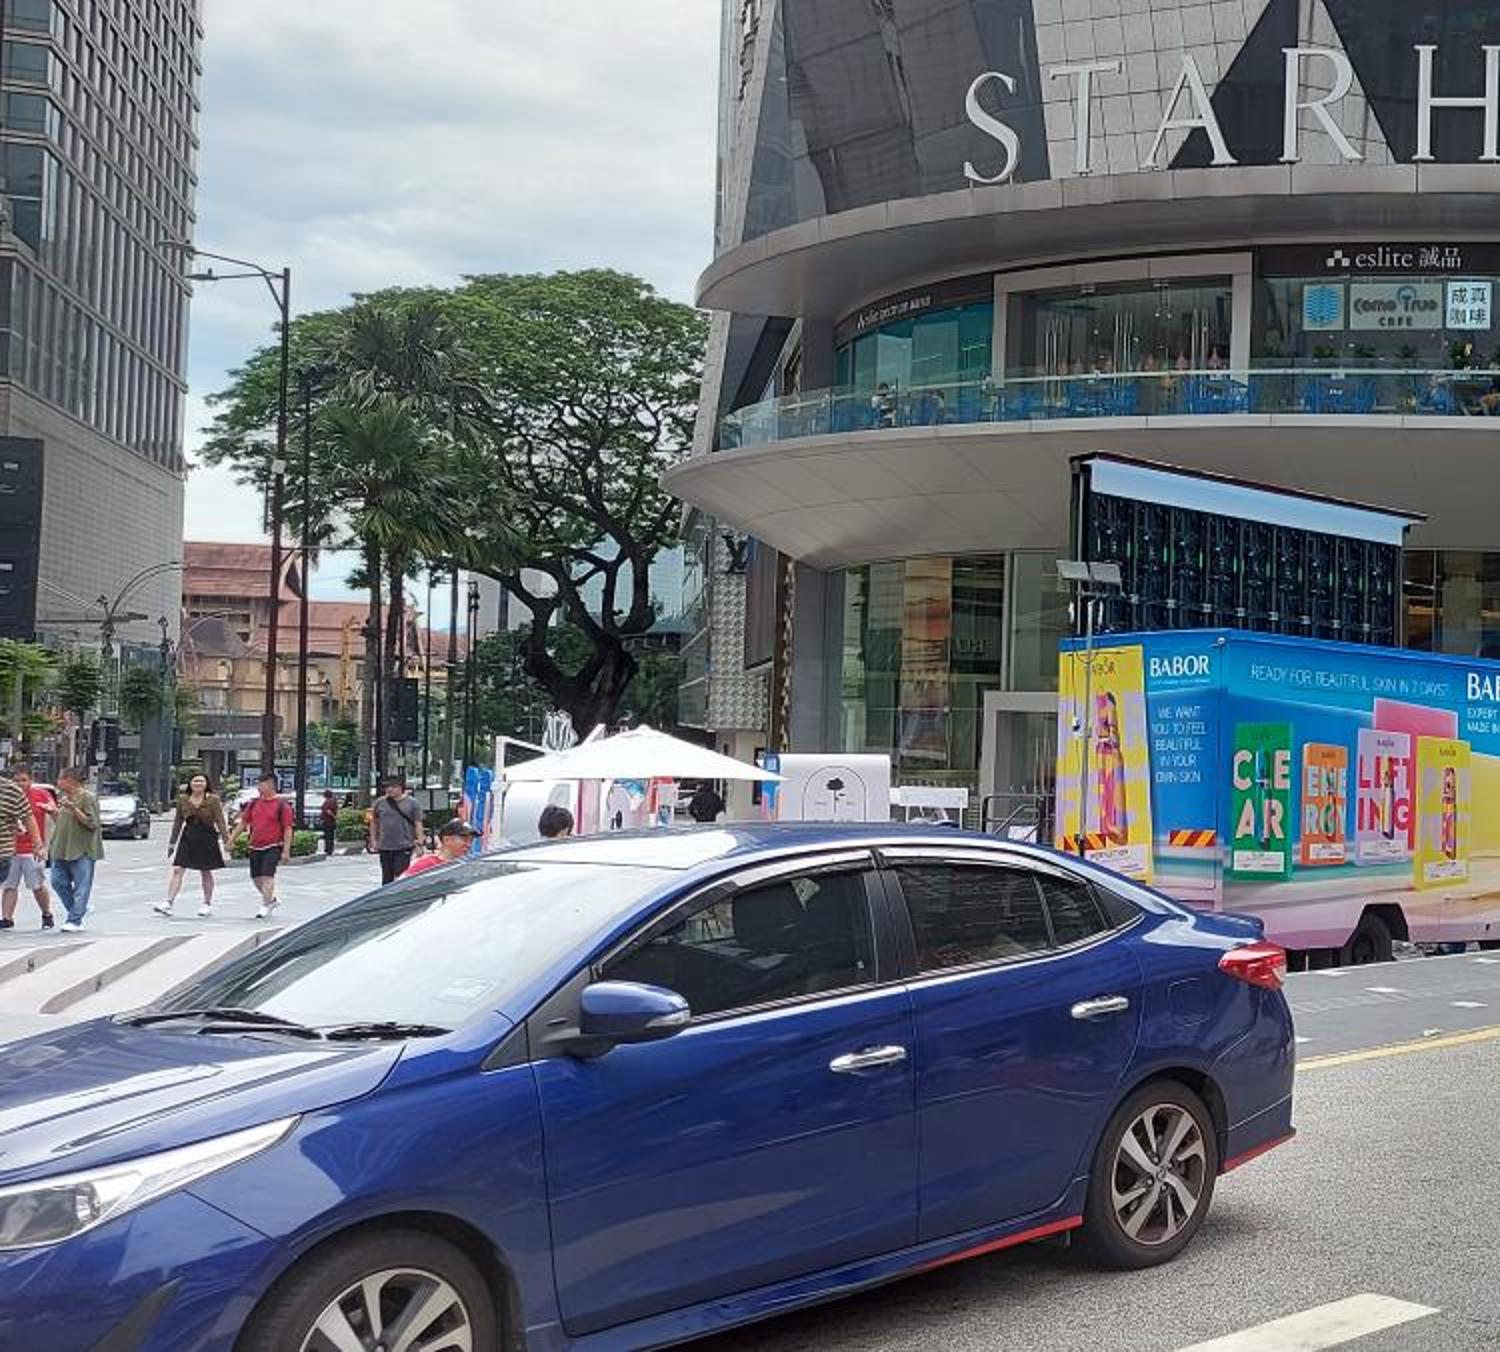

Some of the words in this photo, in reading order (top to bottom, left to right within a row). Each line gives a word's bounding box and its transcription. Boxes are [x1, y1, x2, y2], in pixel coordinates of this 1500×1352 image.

[1355, 247, 1413, 268] eslite
[1419, 247, 1462, 269] 誠品
[1378, 316, 1413, 327] CAFE
[1150, 655, 1211, 678] BABOR
[1251, 664, 1287, 682] READY
[1290, 668, 1313, 686] FOR
[1316, 671, 1370, 692] BEAUTIFUL
[1374, 677, 1397, 692] SKIN
[1399, 680, 1409, 694] IN
[1157, 706, 1173, 719] WE
[1175, 705, 1201, 719] WANT
[1467, 707, 1498, 720] EXPERT
[1152, 722, 1169, 735] YOU
[1173, 722, 1184, 735] TO
[1186, 721, 1206, 735] FEEL
[1467, 721, 1490, 733] MADE
[1155, 739, 1202, 751] BEAUTIFUL
[1159, 755, 1170, 767] IN
[1170, 755, 1197, 768] YOUR
[1155, 771, 1176, 784] OWN
[1179, 771, 1202, 784] SKIN
[1235, 798, 1285, 839] AR
